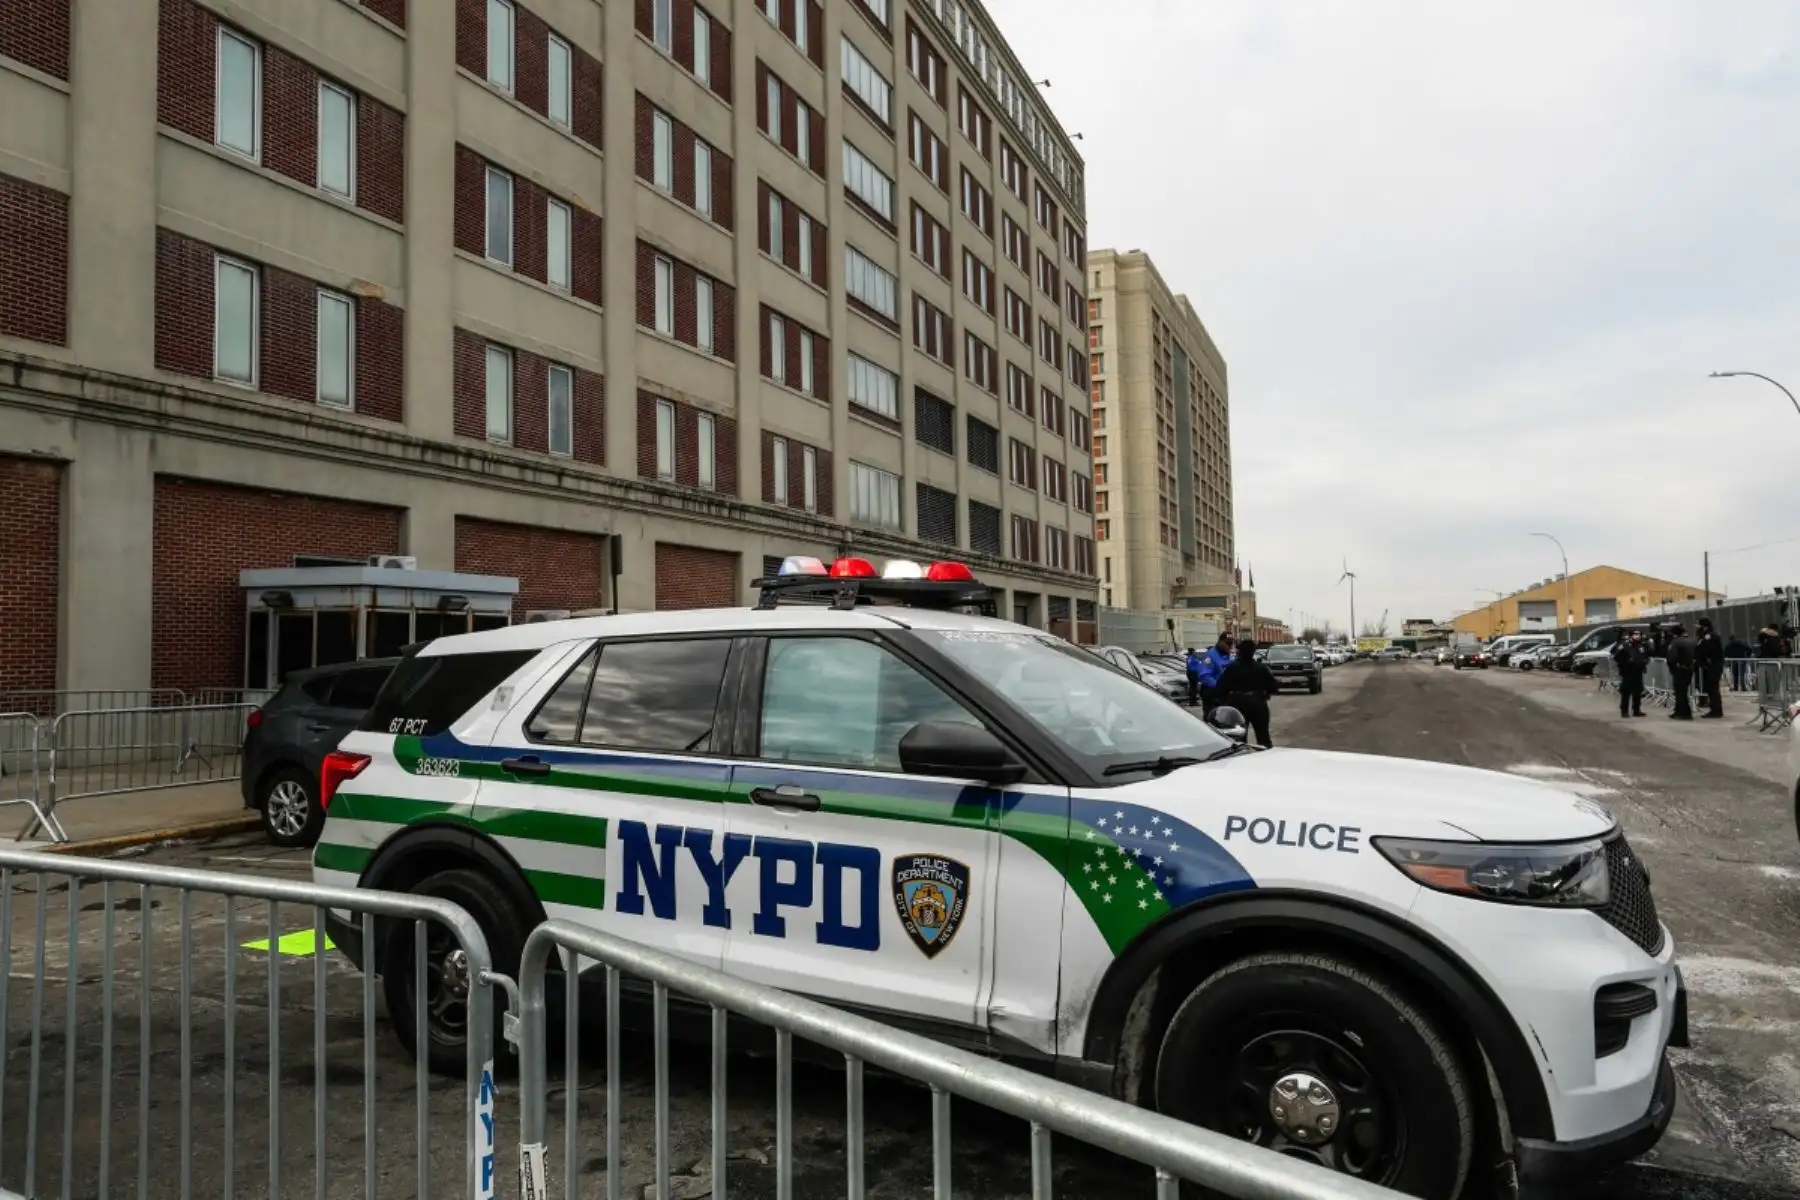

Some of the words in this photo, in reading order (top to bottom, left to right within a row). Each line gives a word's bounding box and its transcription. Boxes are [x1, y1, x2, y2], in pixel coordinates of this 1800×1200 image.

[389, 717, 404, 733] 67
[404, 719, 428, 734] PCT
[416, 758, 460, 777] 363623
[1223, 815, 1361, 854] POLICE
[897, 868, 964, 889] DEPARTMENT
[912, 857, 950, 872] POLICE
[616, 819, 881, 951] NYPD
[896, 893, 909, 918] CITY
[905, 921, 918, 935] OF
[940, 923, 954, 944] NEW
[950, 898, 965, 922] YORK
[480, 1069, 494, 1200] NYP
